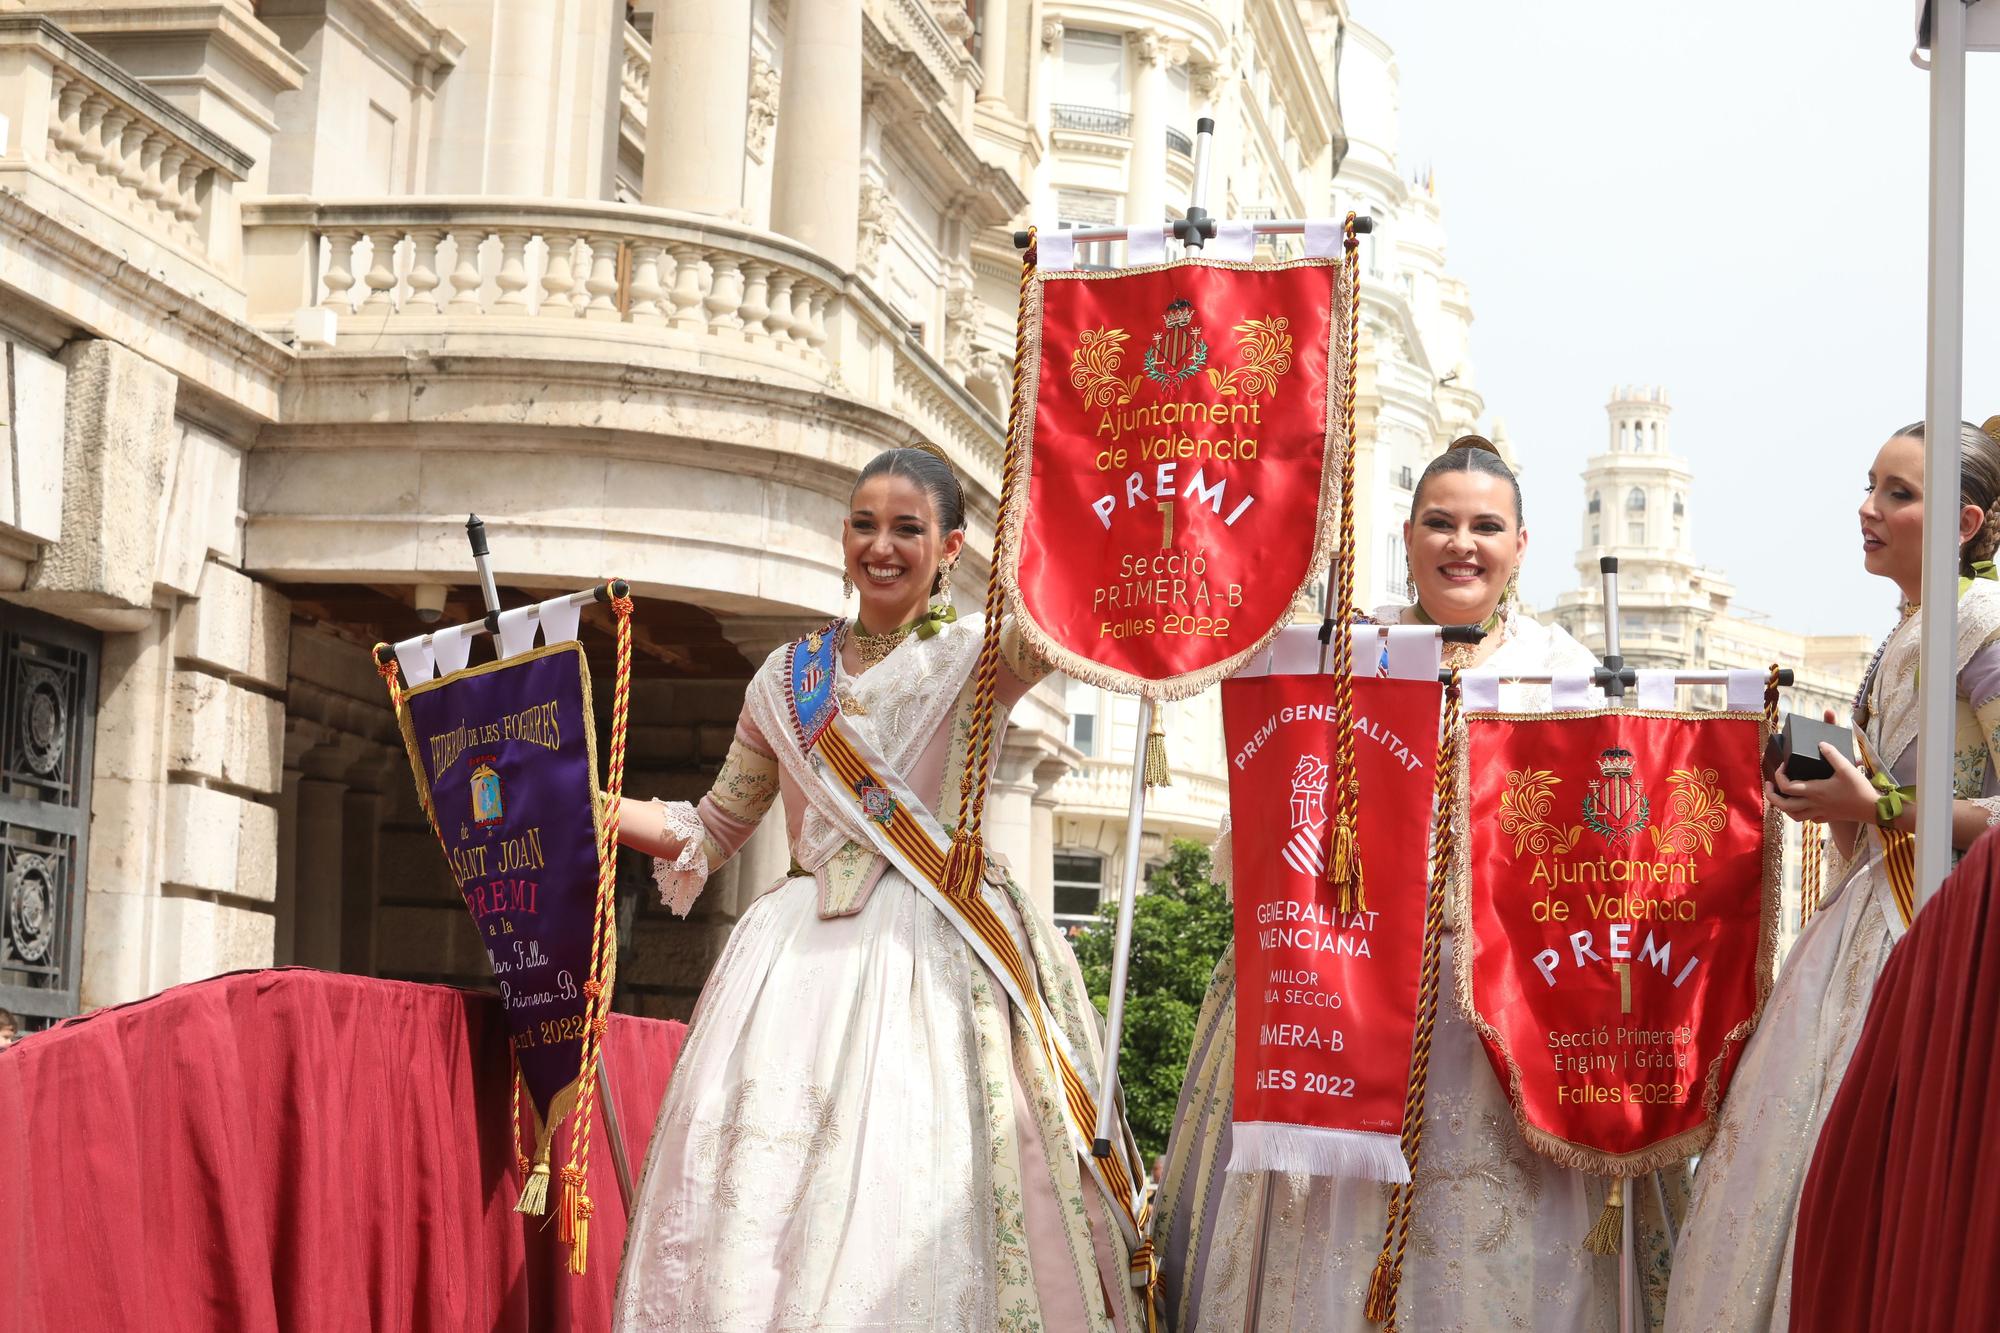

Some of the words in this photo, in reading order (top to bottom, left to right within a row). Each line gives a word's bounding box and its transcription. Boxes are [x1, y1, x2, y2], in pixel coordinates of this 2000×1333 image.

[1096, 399, 1261, 441] Ajuntament
[1095, 445, 1128, 471] de
[1140, 431, 1257, 461] València
[1092, 462, 1255, 530] PREMI
[1157, 501, 1174, 548] 1
[1120, 548, 1206, 578] Secció
[1100, 618, 1156, 639] Falles
[1163, 614, 1230, 637] 2022
[430, 718, 467, 784] FEDERAÓ
[468, 728, 479, 747] DE
[480, 723, 500, 743] LES
[1234, 714, 1278, 771] PREMI
[1280, 704, 1424, 772] GENEALITAT
[461, 821, 469, 840] de
[454, 844, 488, 888] SANT
[498, 827, 545, 873] JOAN
[1529, 855, 1699, 891] Ajuntament
[466, 879, 539, 918] PREMI
[1532, 895, 1570, 922] de
[1586, 889, 1696, 921] València
[489, 924, 497, 936] a
[501, 917, 514, 934] la
[513, 940, 549, 970] Falla
[1259, 928, 1372, 959] VALENCIANA
[1532, 923, 1699, 988] PREMI
[1269, 970, 1319, 986] MILLOR
[1612, 963, 1632, 1014] 1
[1284, 989, 1342, 1009] SECCIÓ
[540, 1015, 584, 1044] 2022
[1548, 1025, 1609, 1048] Secció
[1554, 1052, 1617, 1074] Enginy
[1623, 1052, 1628, 1068] i
[1635, 1048, 1687, 1068] Gràcia
[1303, 1072, 1356, 1098] 2022
[1558, 1084, 1622, 1105] Falles
[1629, 1083, 1684, 1105] 2022
